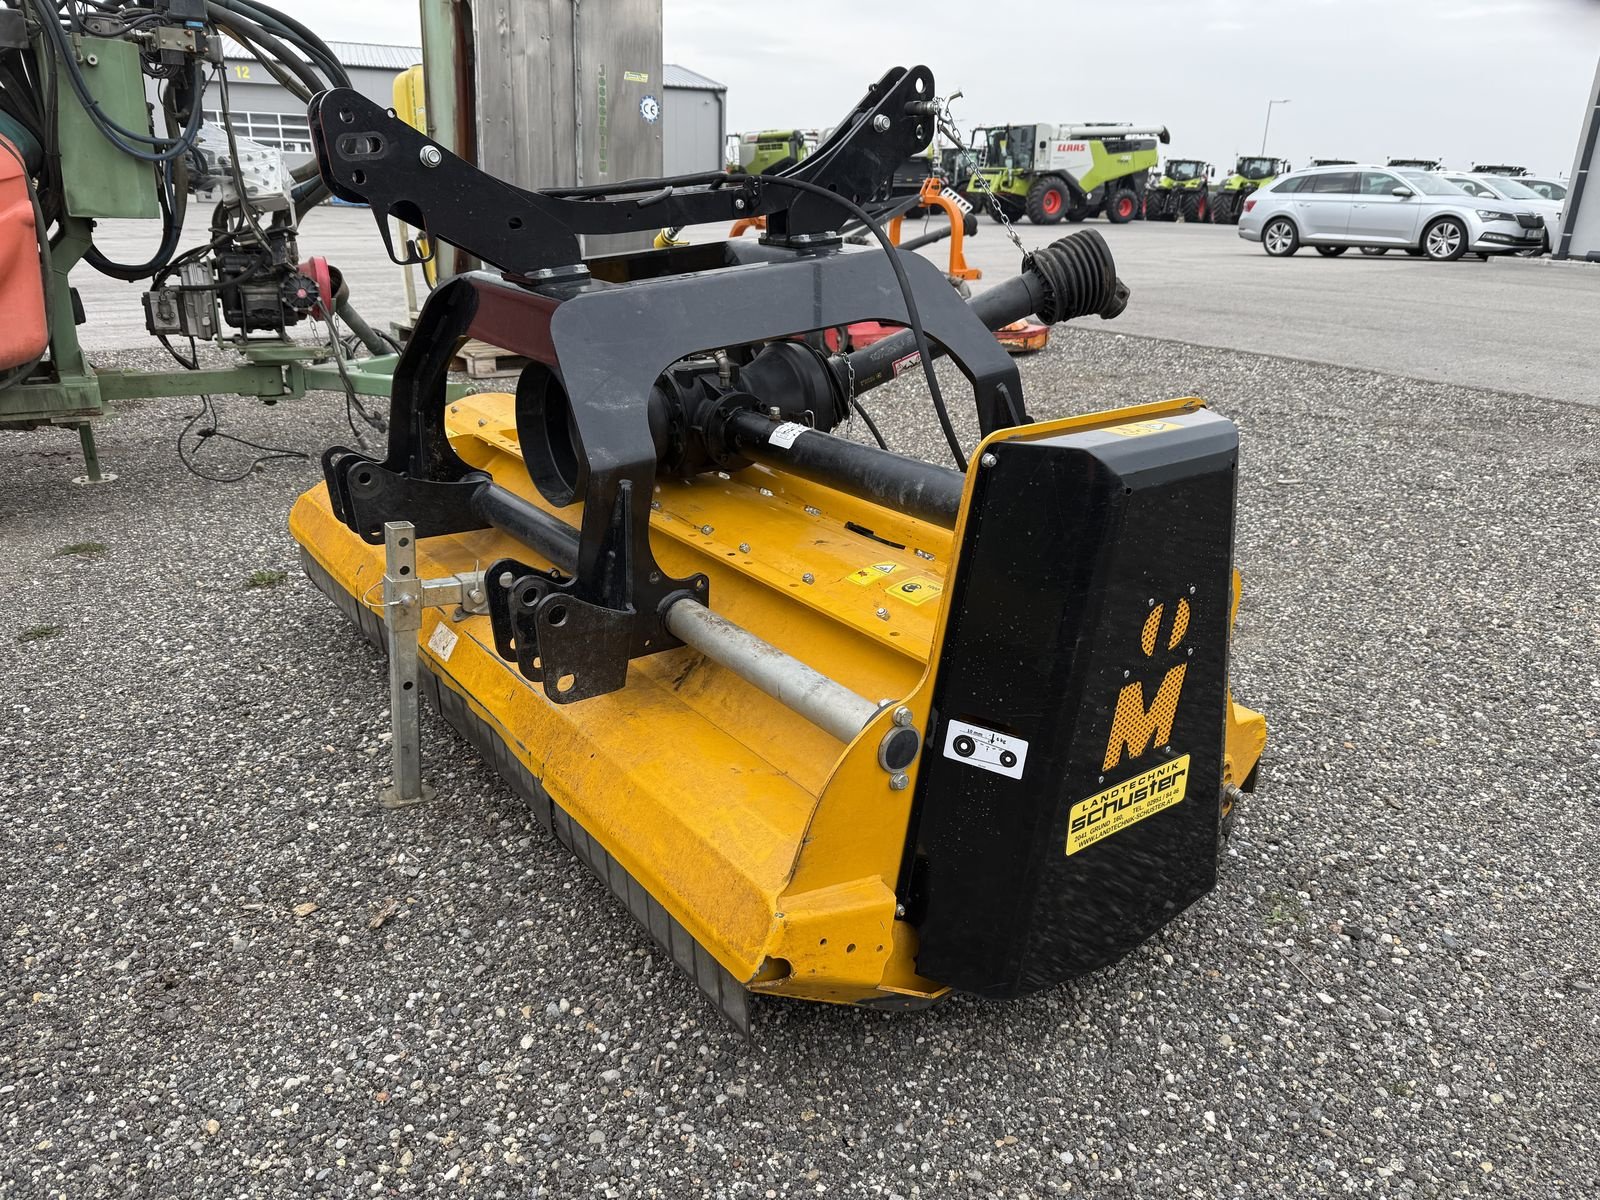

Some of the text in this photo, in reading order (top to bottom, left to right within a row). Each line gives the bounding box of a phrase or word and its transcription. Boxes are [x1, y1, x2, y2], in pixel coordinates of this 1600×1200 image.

[234, 65, 250, 79] 12
[1057, 144, 1085, 152] CLAAS
[1082, 762, 1179, 812] LANDTECHNIK
[1078, 798, 1174, 848] WWW.LANDTECHNIK-SCHUSTER.AT
[1089, 821, 1111, 834] GRUND
[1132, 806, 1144, 814] TEL.
